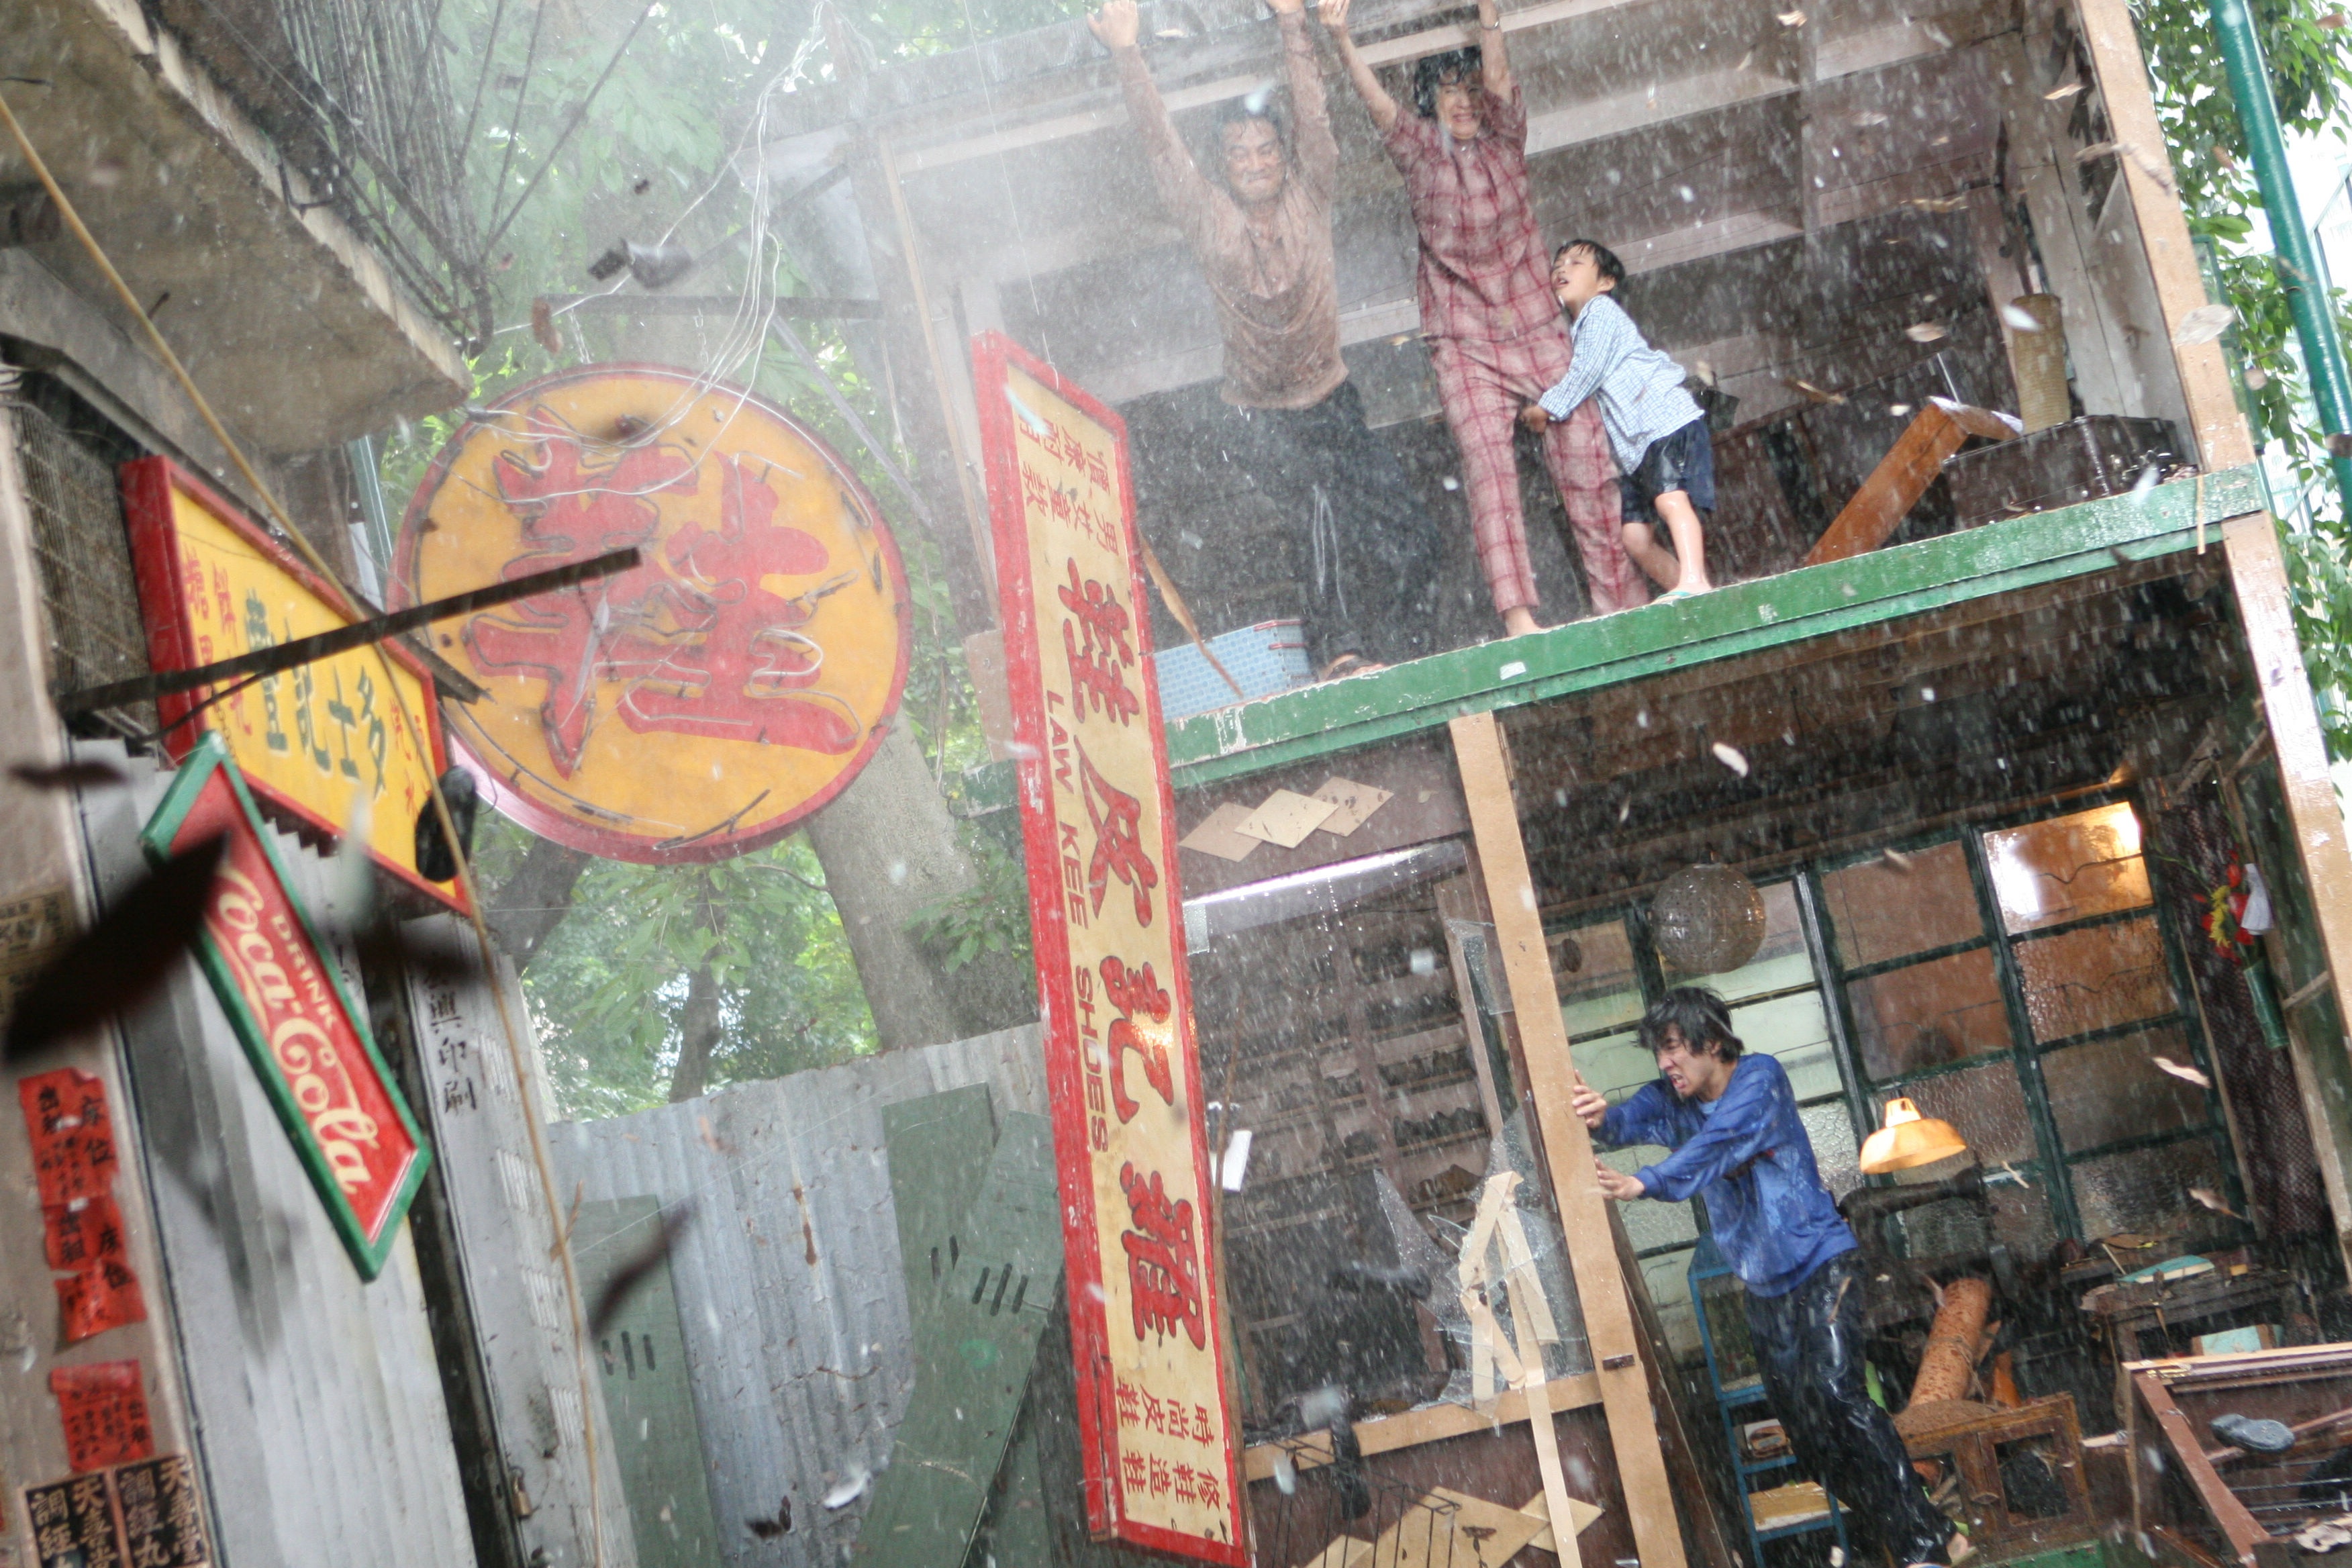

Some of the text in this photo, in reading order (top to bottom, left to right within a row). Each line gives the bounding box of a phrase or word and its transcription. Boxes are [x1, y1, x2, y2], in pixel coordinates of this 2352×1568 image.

[1022, 460, 1118, 554] 男女童款
[465, 405, 856, 781] 鞋
[272, 913, 337, 1030] DRINK
[1046, 689, 1109, 1153] LAW KEE SHOES
[1058, 556, 1206, 1351] 羅記皮鞋
[1116, 1375, 1215, 1449] 時尚皮鞋
[30, 1487, 78, 1568] 調經
[1122, 1447, 1220, 1512] 修鞋造鞋
